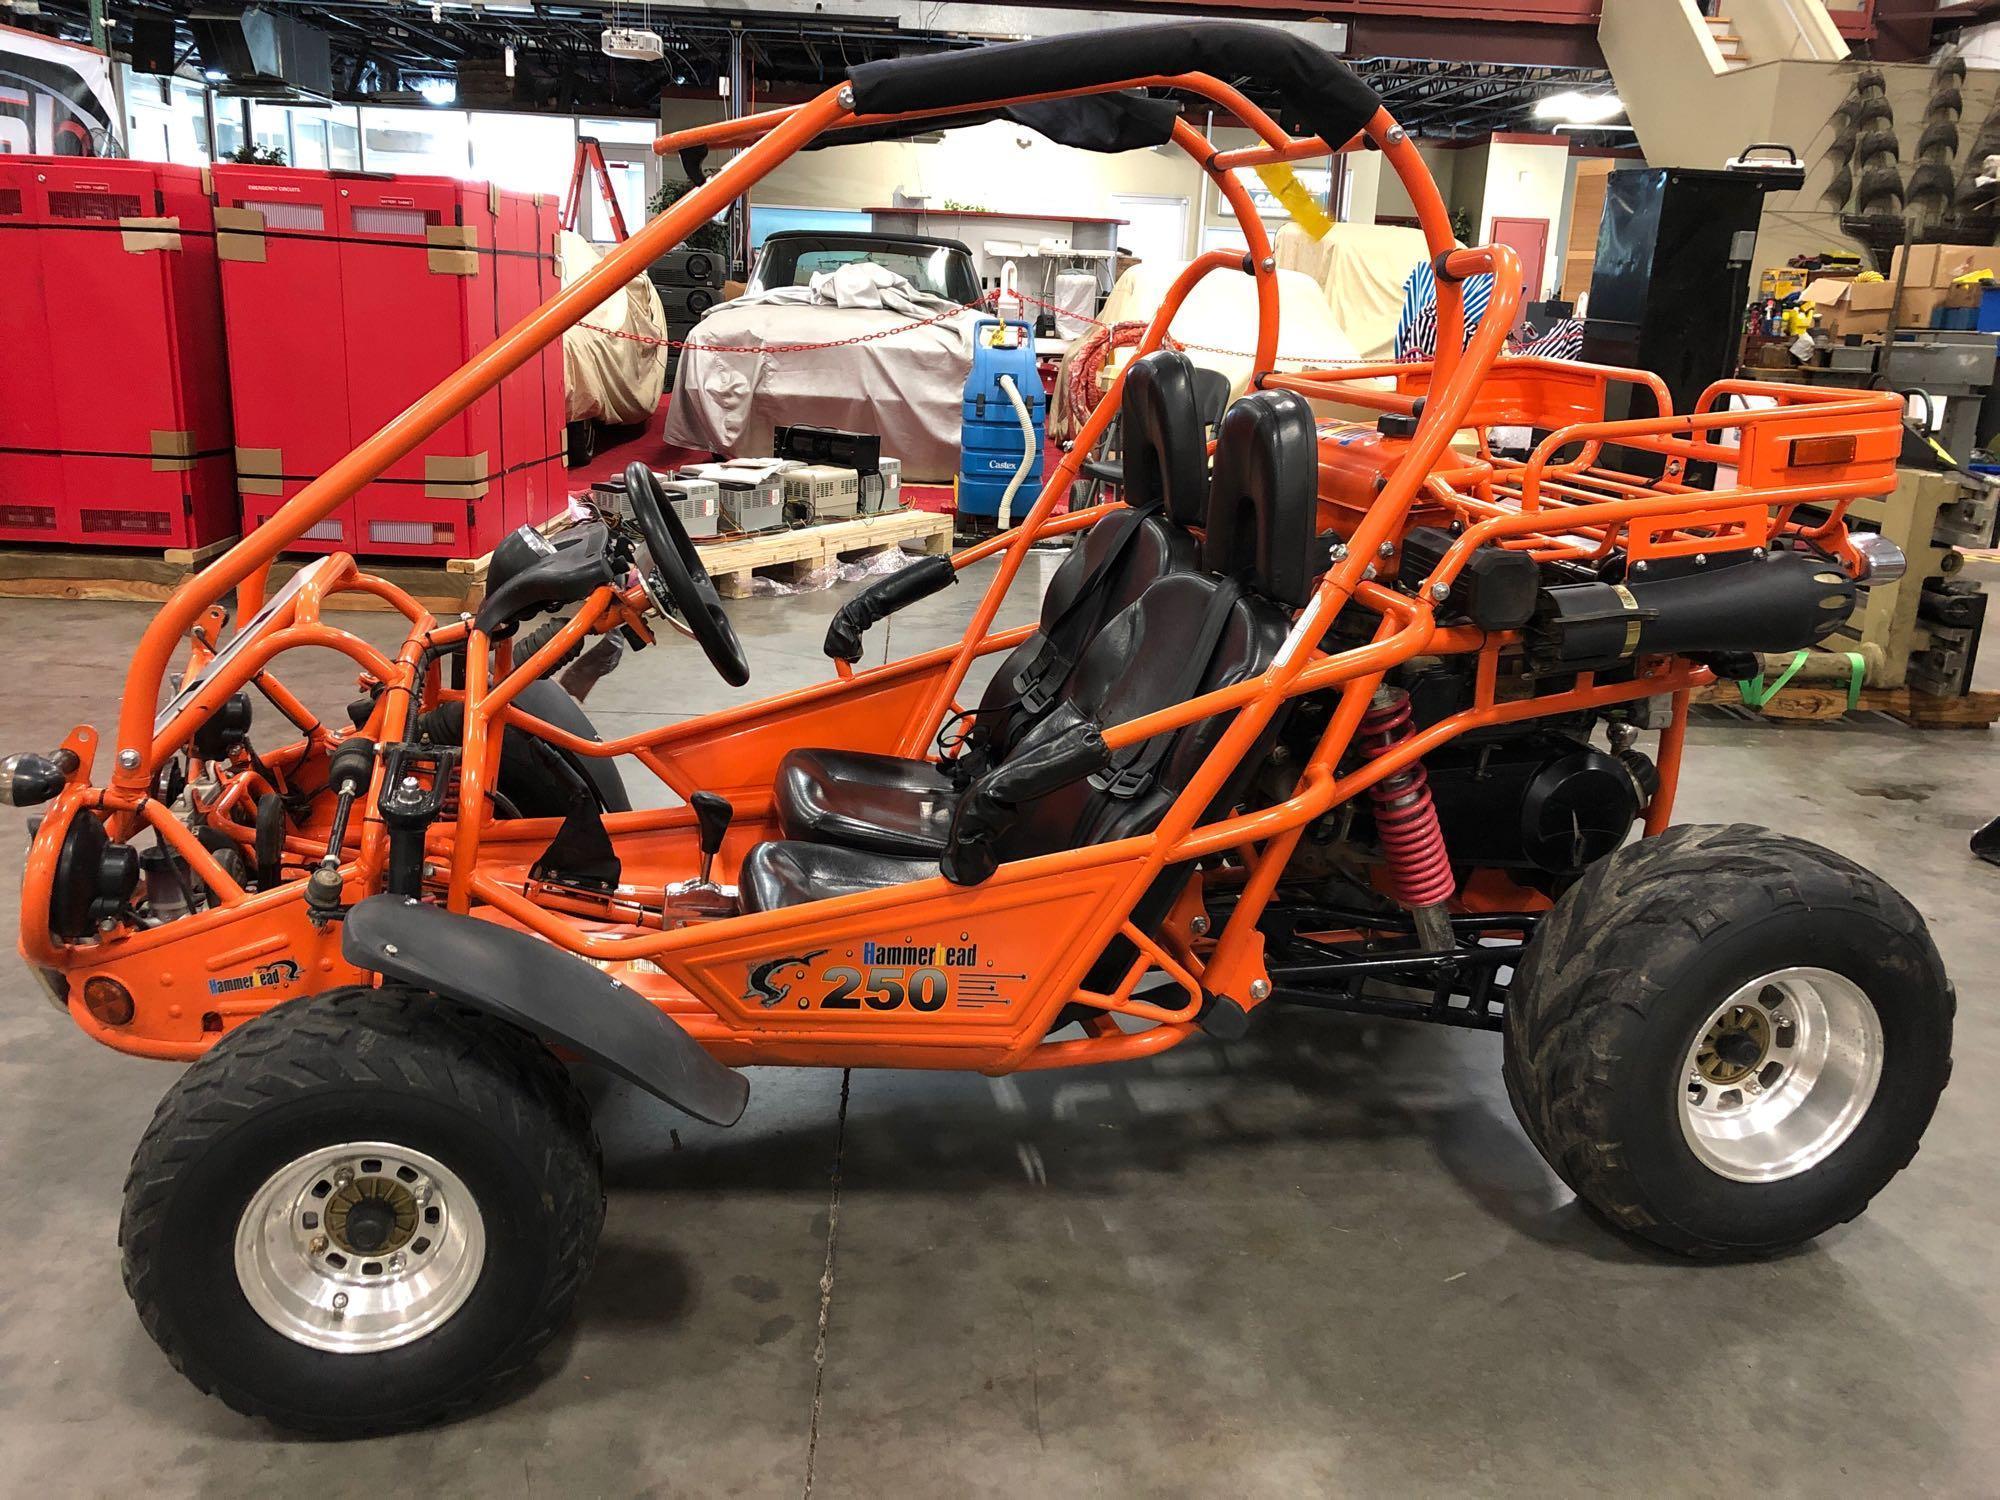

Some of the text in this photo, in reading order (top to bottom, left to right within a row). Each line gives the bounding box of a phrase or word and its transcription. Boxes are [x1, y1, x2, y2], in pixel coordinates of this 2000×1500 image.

[989, 460, 1016, 469] Castex
[863, 942, 977, 966] Hammerhead
[209, 969, 280, 994] Hammerhead
[819, 966, 949, 1012] 250
